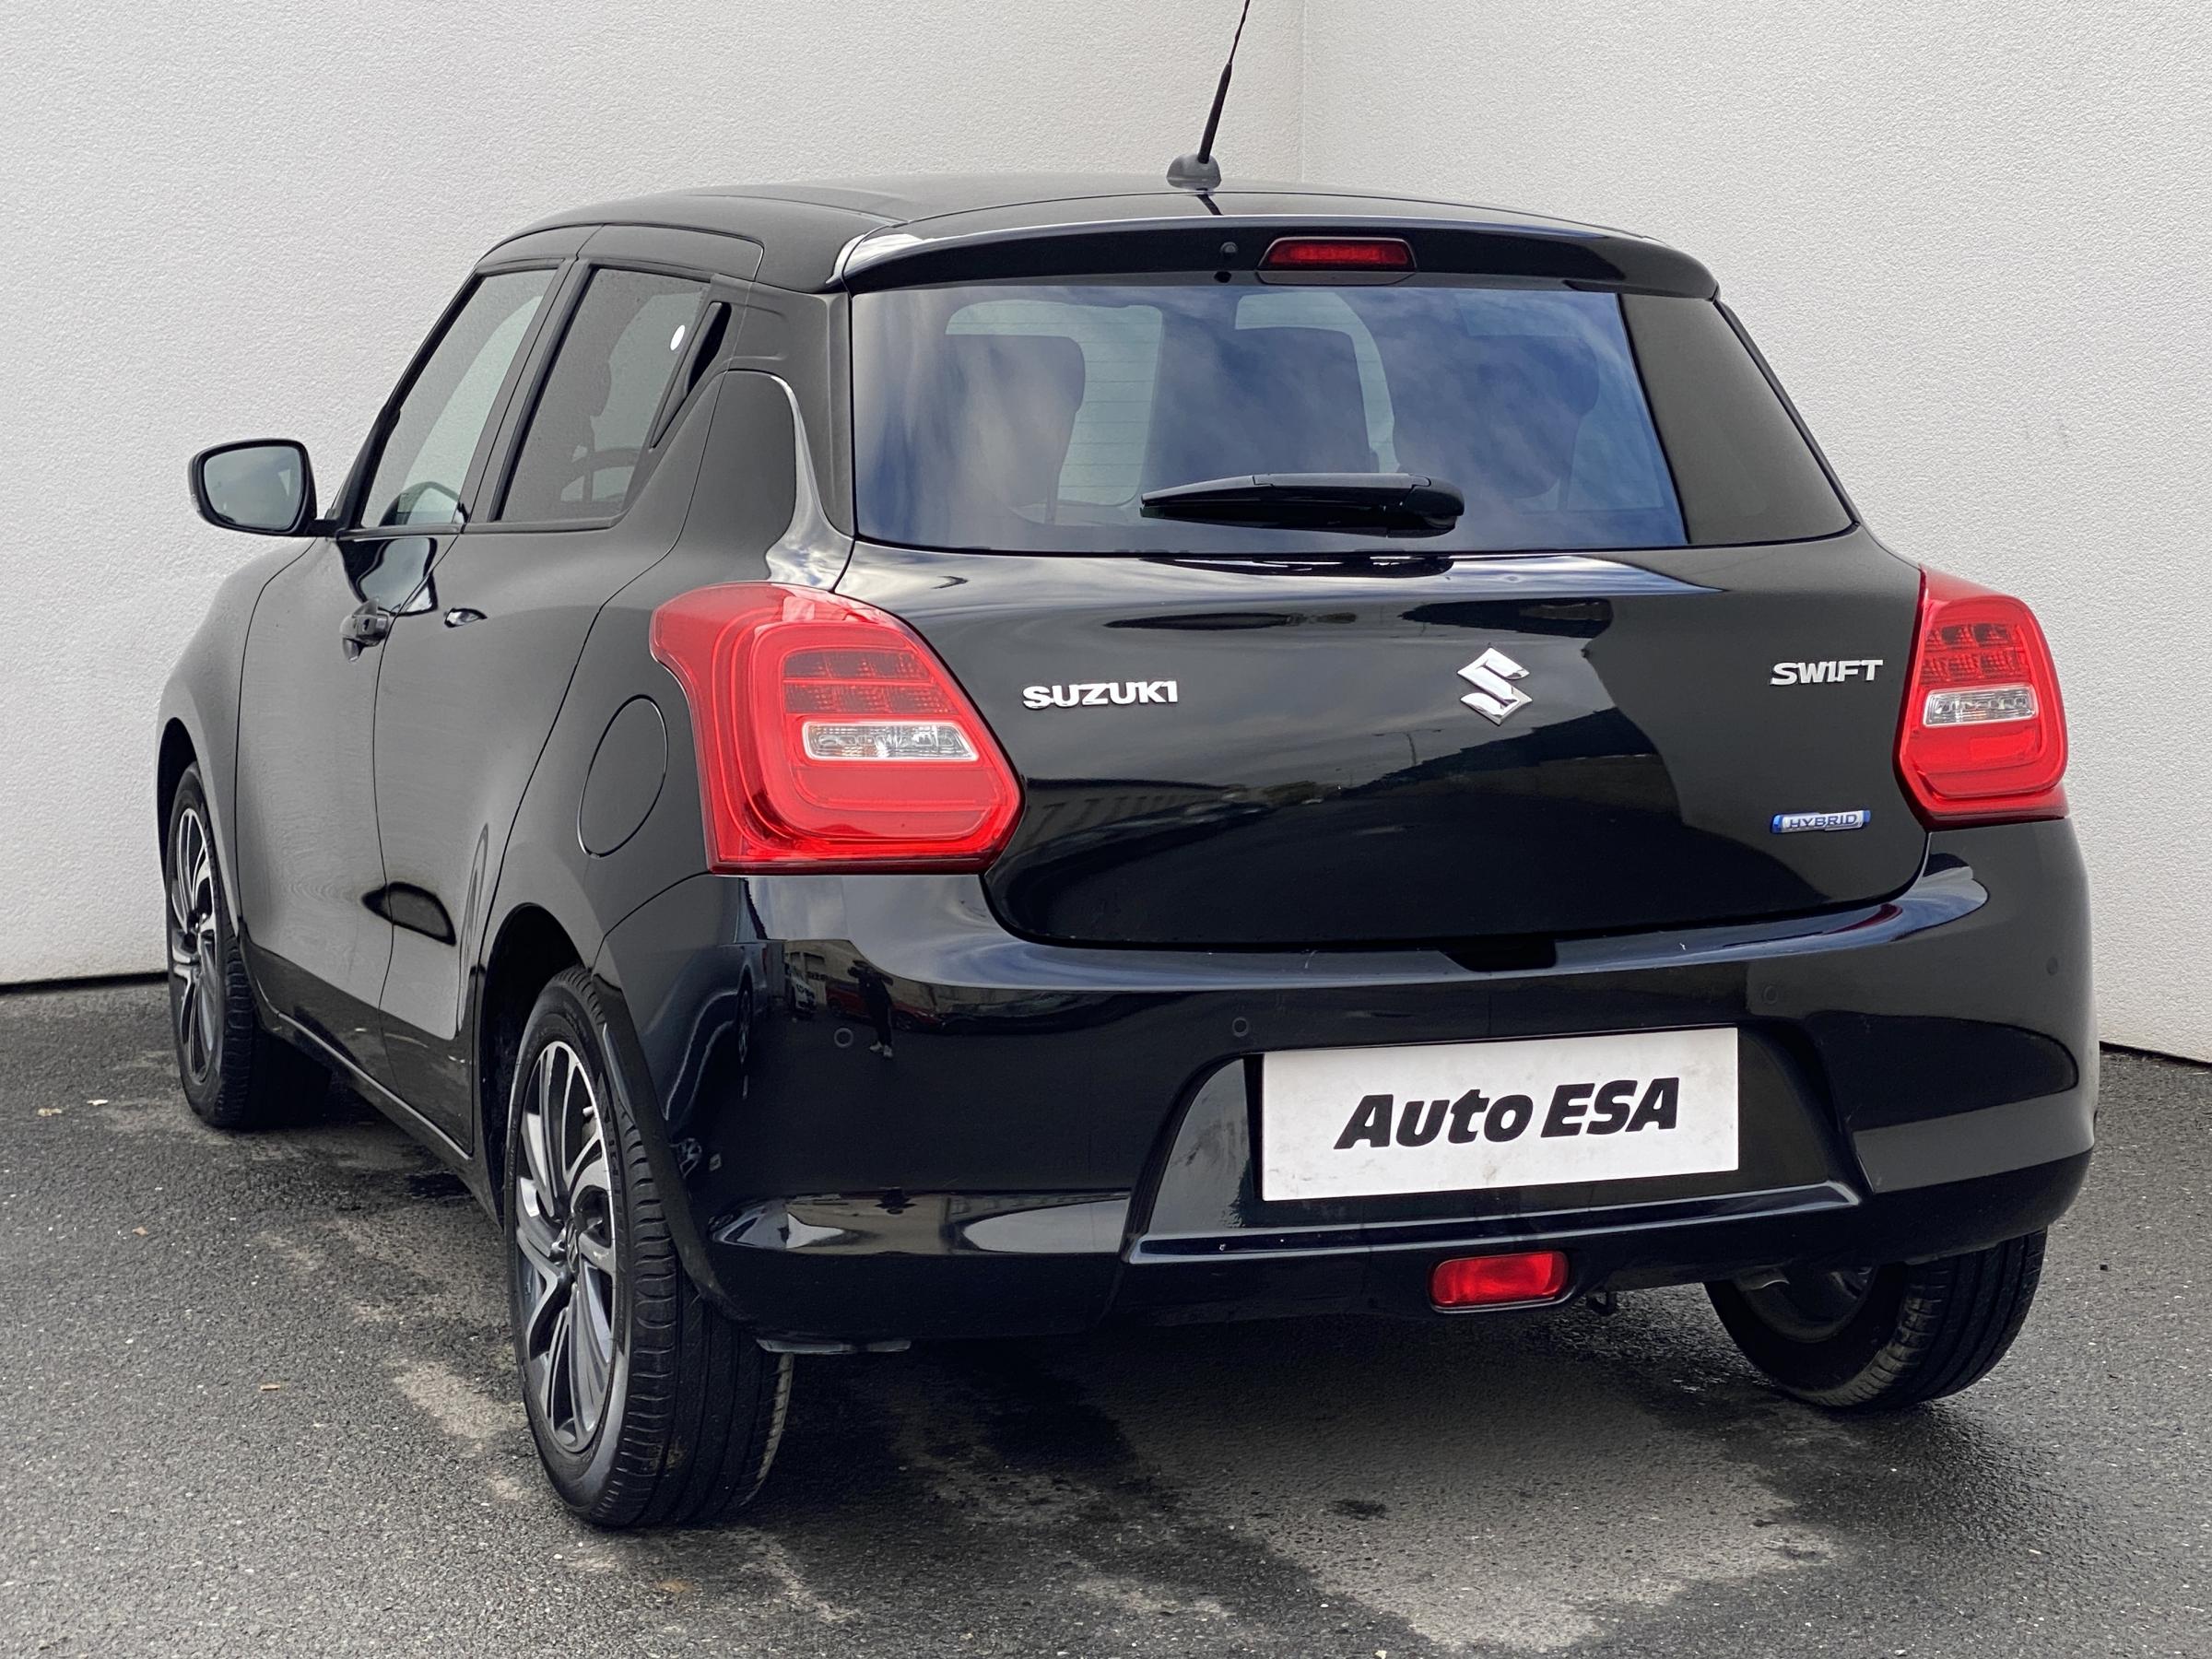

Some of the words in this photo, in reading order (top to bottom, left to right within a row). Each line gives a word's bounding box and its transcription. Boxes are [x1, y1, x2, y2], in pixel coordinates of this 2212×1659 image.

[1770, 659, 1883, 686] SWIFT
[1023, 680, 1178, 709] SUZUKI
[1789, 814, 1858, 828] HYBRID
[1334, 1089, 1534, 1149] Auto
[1540, 1077, 1679, 1137] ESA
